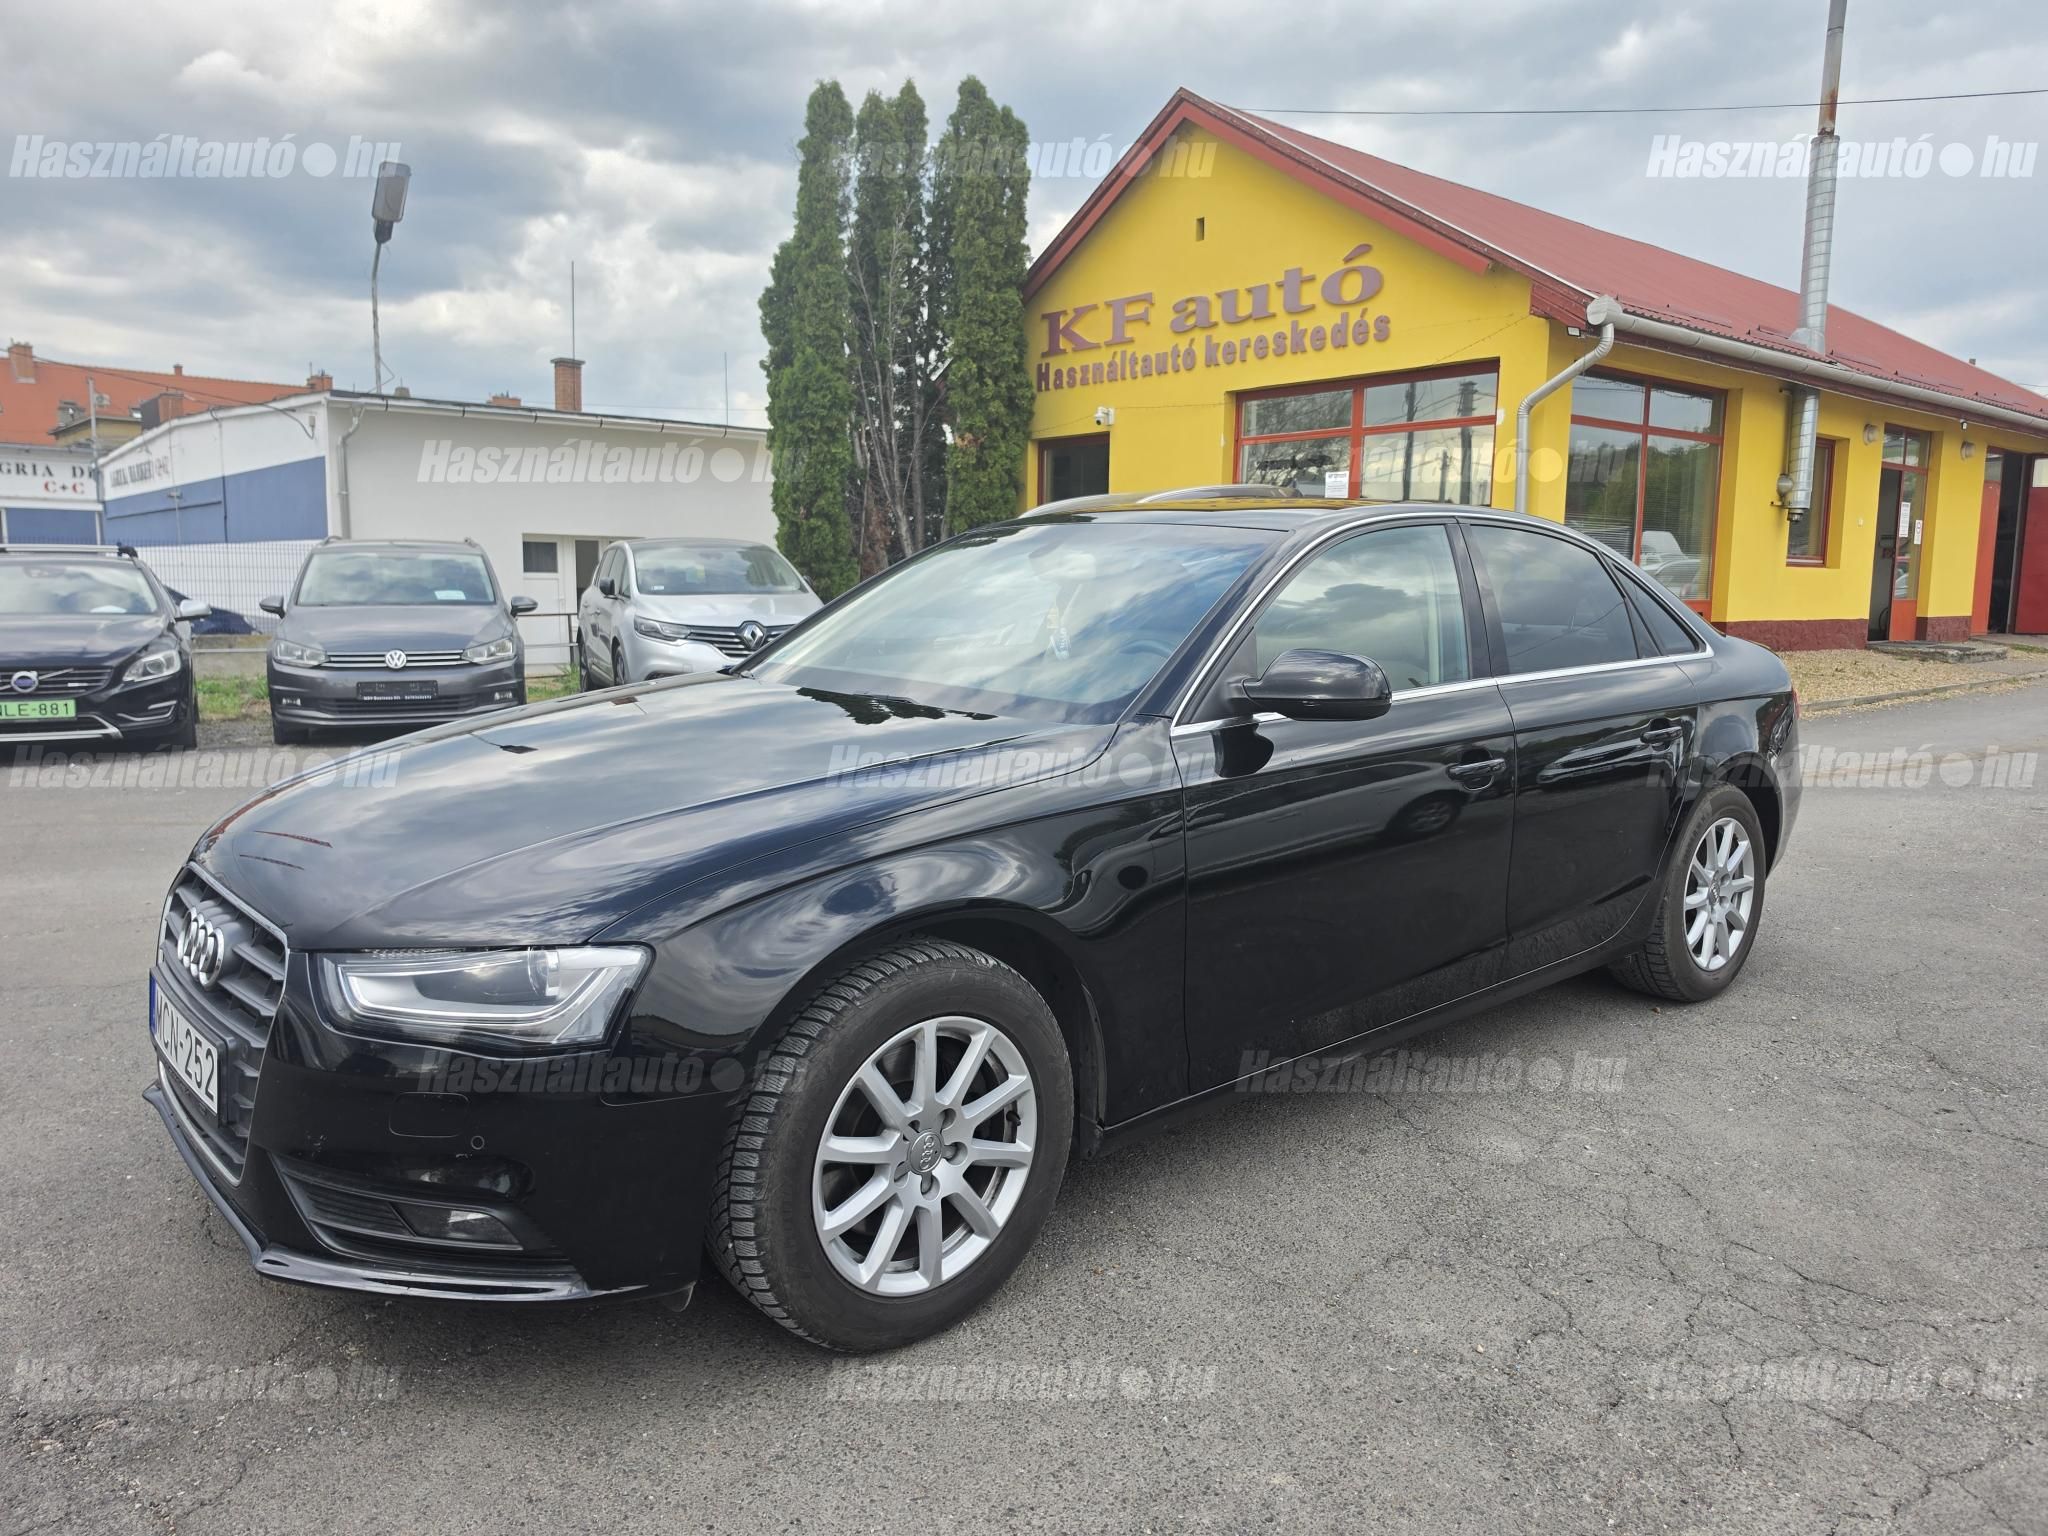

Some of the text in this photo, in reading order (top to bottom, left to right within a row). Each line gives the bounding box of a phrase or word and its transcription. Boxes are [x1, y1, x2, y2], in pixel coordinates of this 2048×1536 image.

[1041, 243, 1385, 358] KF autó
[1037, 308, 1391, 393] Használtautó kereskedés
[0, 702, 69, 717] LE-881
